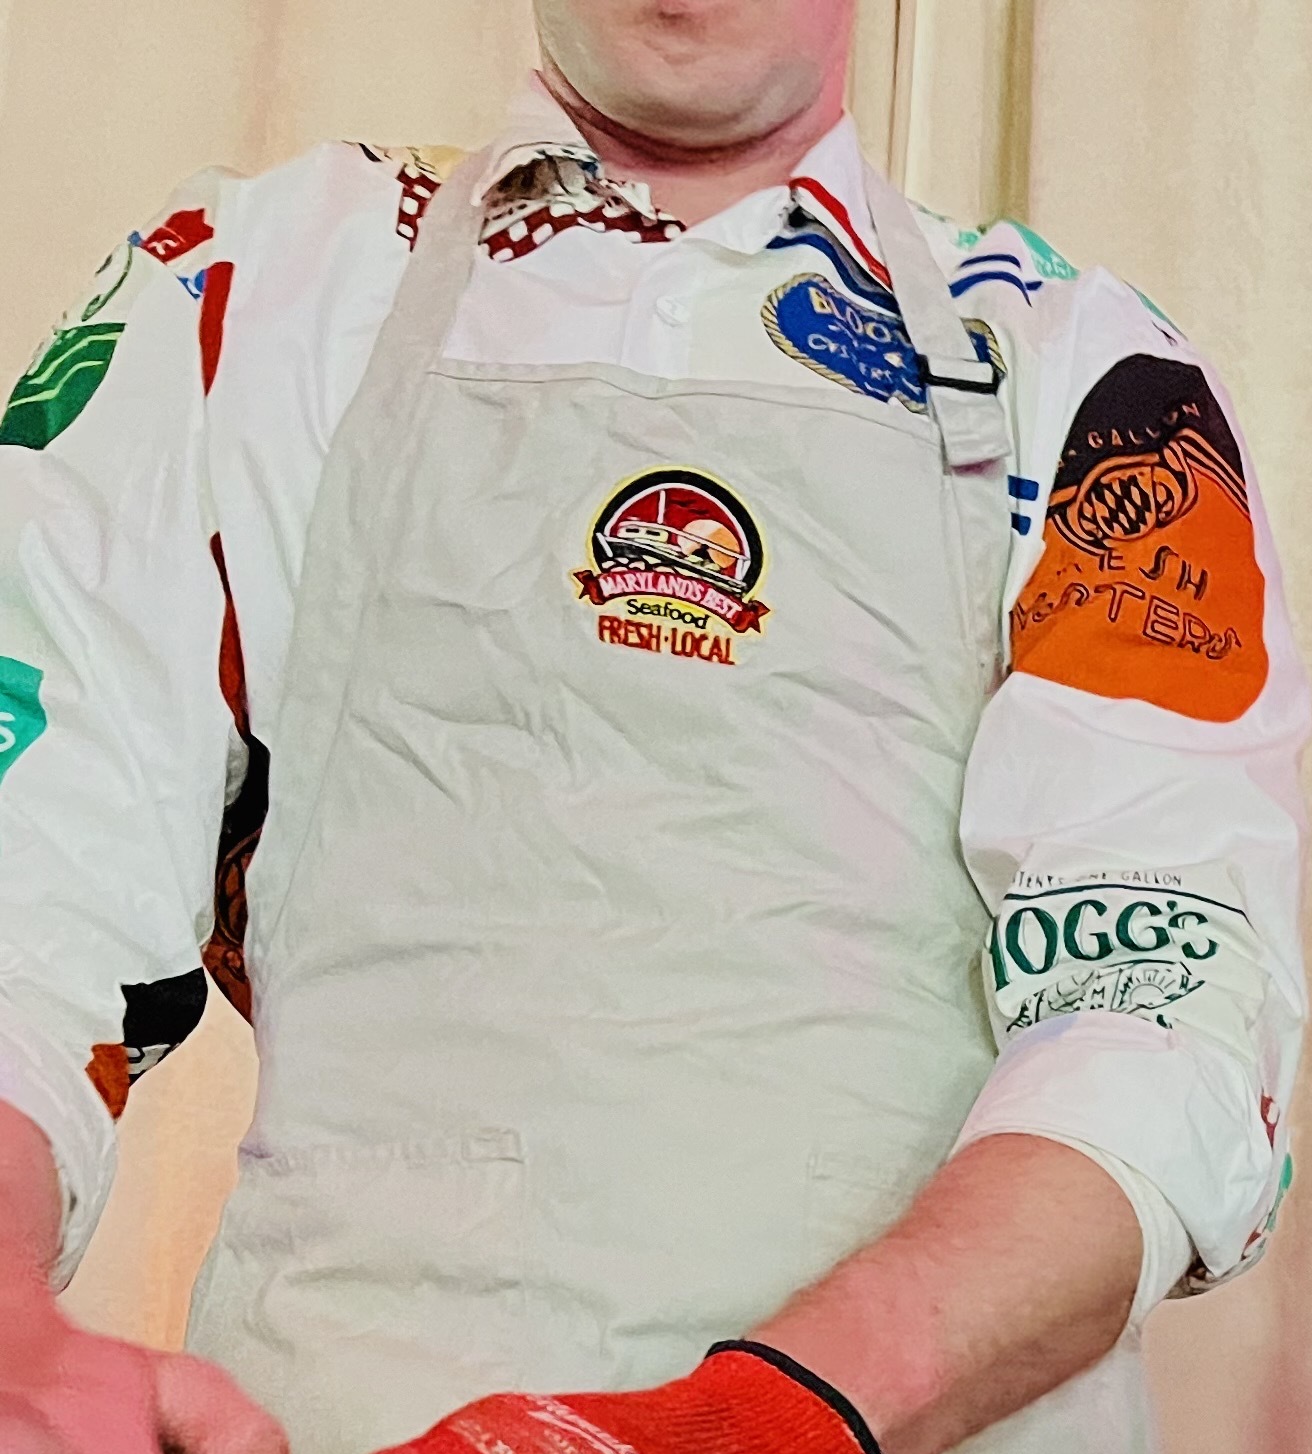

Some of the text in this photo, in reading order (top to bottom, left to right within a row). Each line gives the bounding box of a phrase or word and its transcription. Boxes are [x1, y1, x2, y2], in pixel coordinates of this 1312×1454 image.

[626, 599, 710, 630] Seafood
[701, 588, 743, 618] BEST
[671, 627, 735, 666] LOCAL
